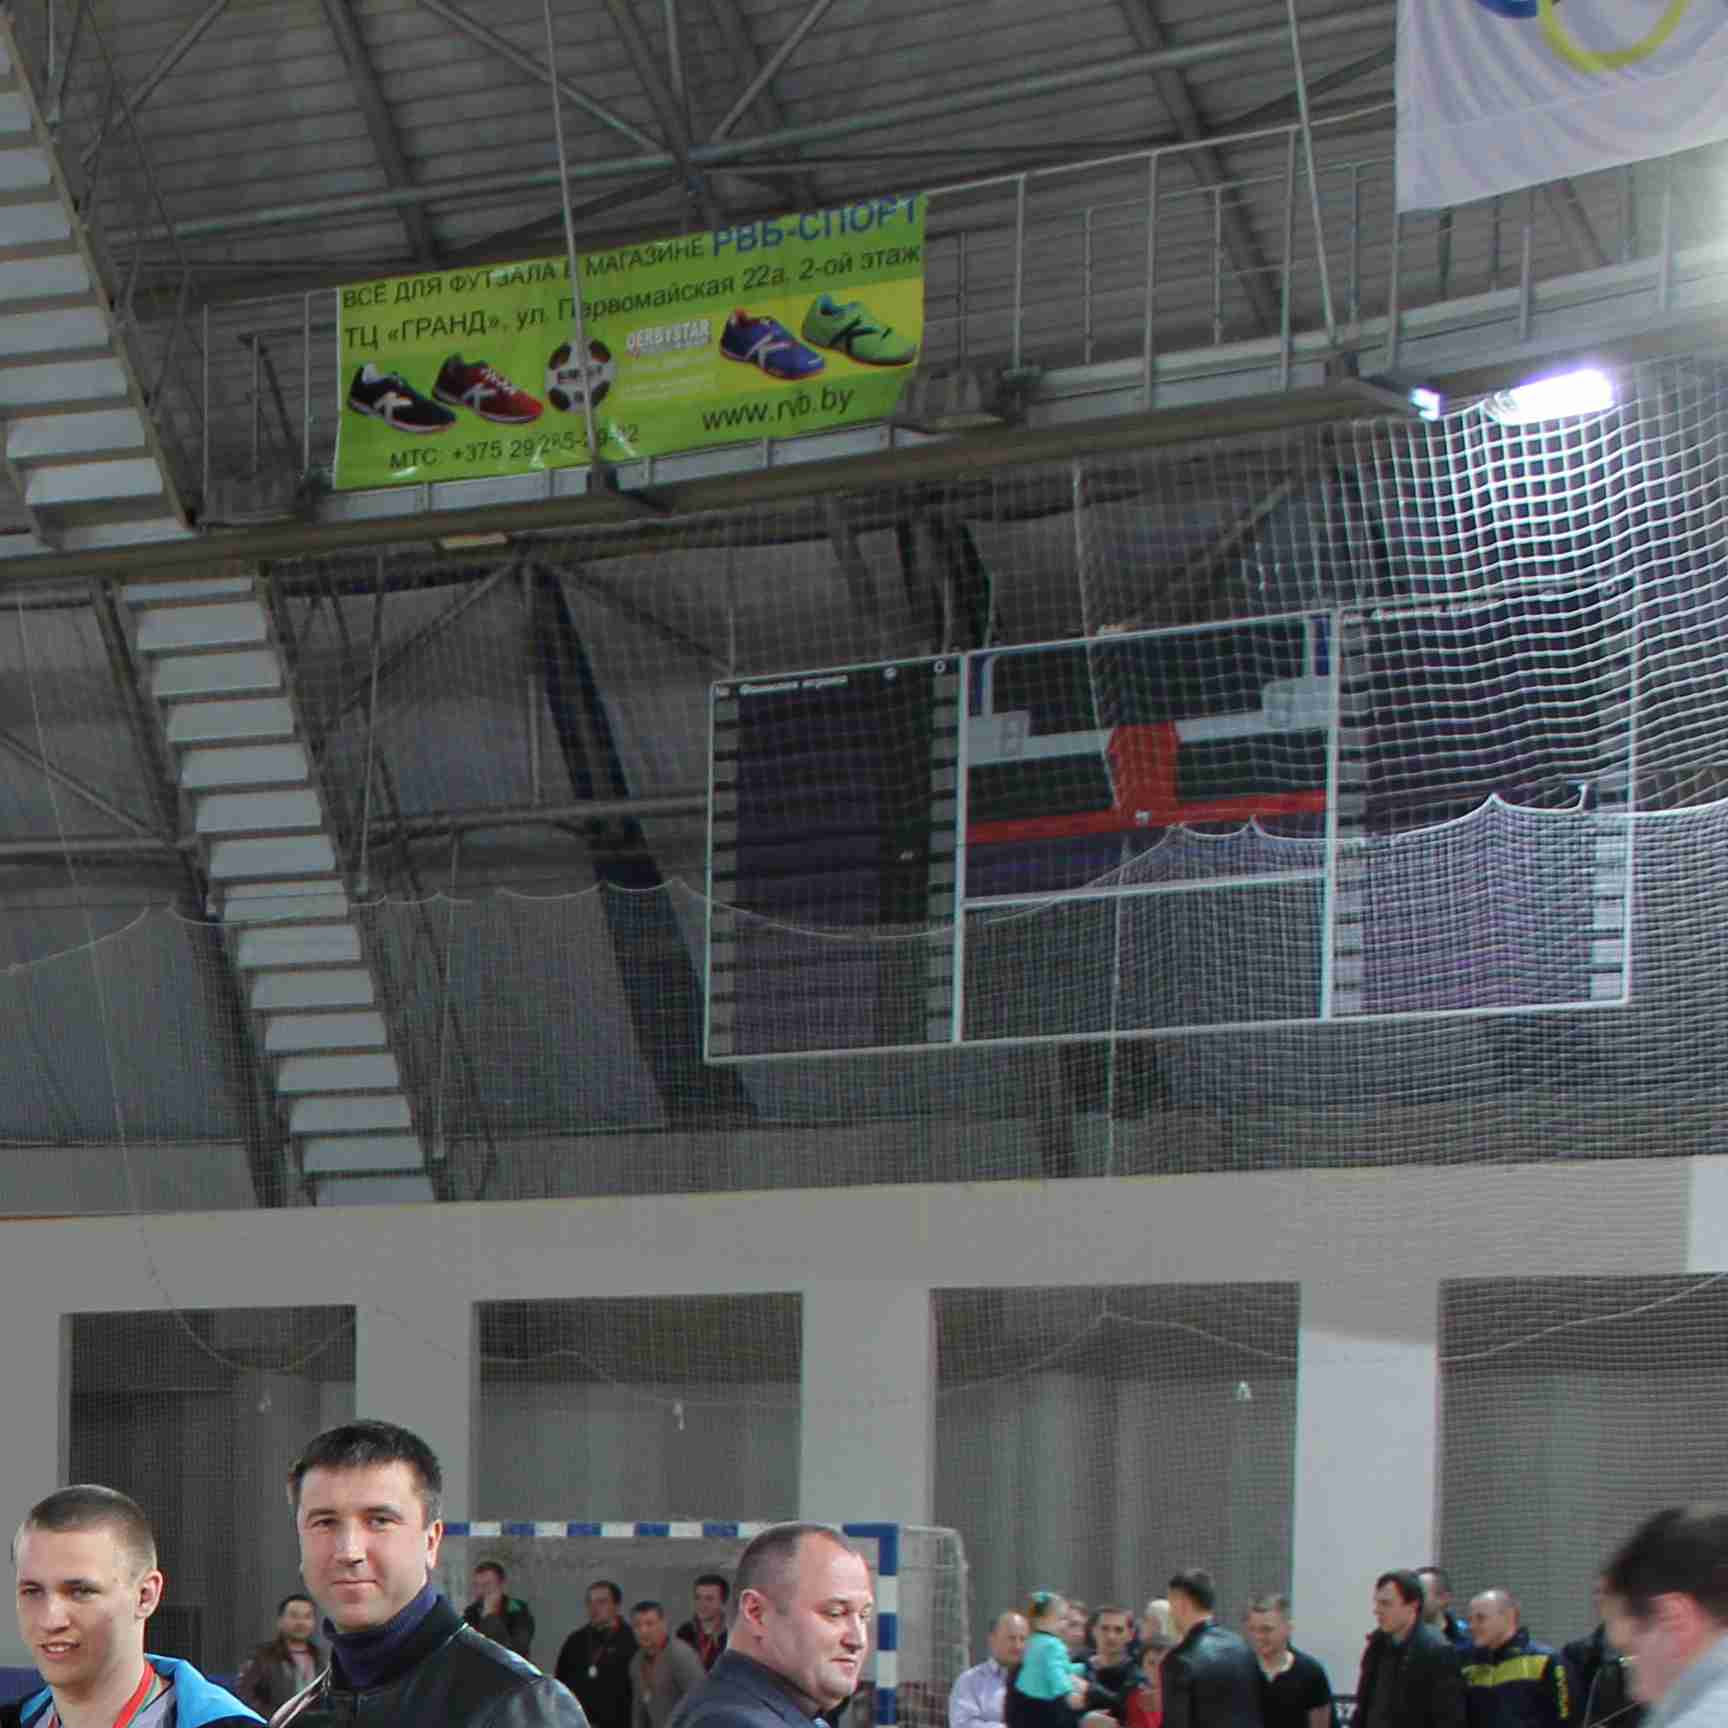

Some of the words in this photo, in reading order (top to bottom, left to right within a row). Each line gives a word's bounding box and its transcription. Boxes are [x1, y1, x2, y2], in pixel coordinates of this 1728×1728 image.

[343, 284, 387, 308] ВСЕ
[394, 277, 442, 305] ДЛЯ
[585, 238, 705, 277] МАГАЗИНЕ
[345, 325, 379, 350] ТЦ
[861, 245, 921, 271] этаж
